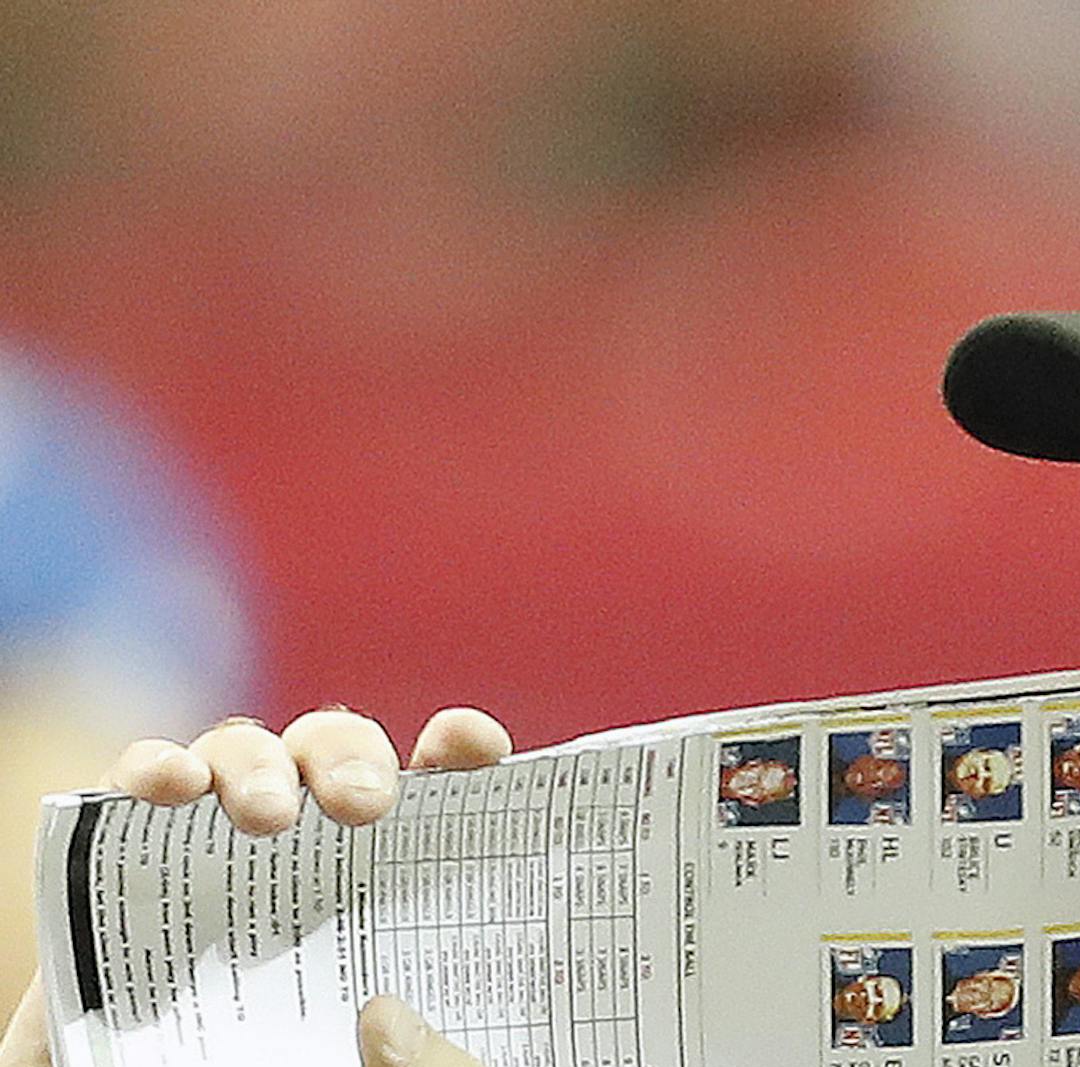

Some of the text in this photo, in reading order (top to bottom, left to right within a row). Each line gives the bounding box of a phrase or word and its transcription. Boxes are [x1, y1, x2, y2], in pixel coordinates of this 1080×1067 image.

[771, 838, 790, 860] LJ
[881, 836, 900, 864] HL
[993, 833, 1014, 849] U
[683, 862, 697, 978] CONTROL THE BALL
